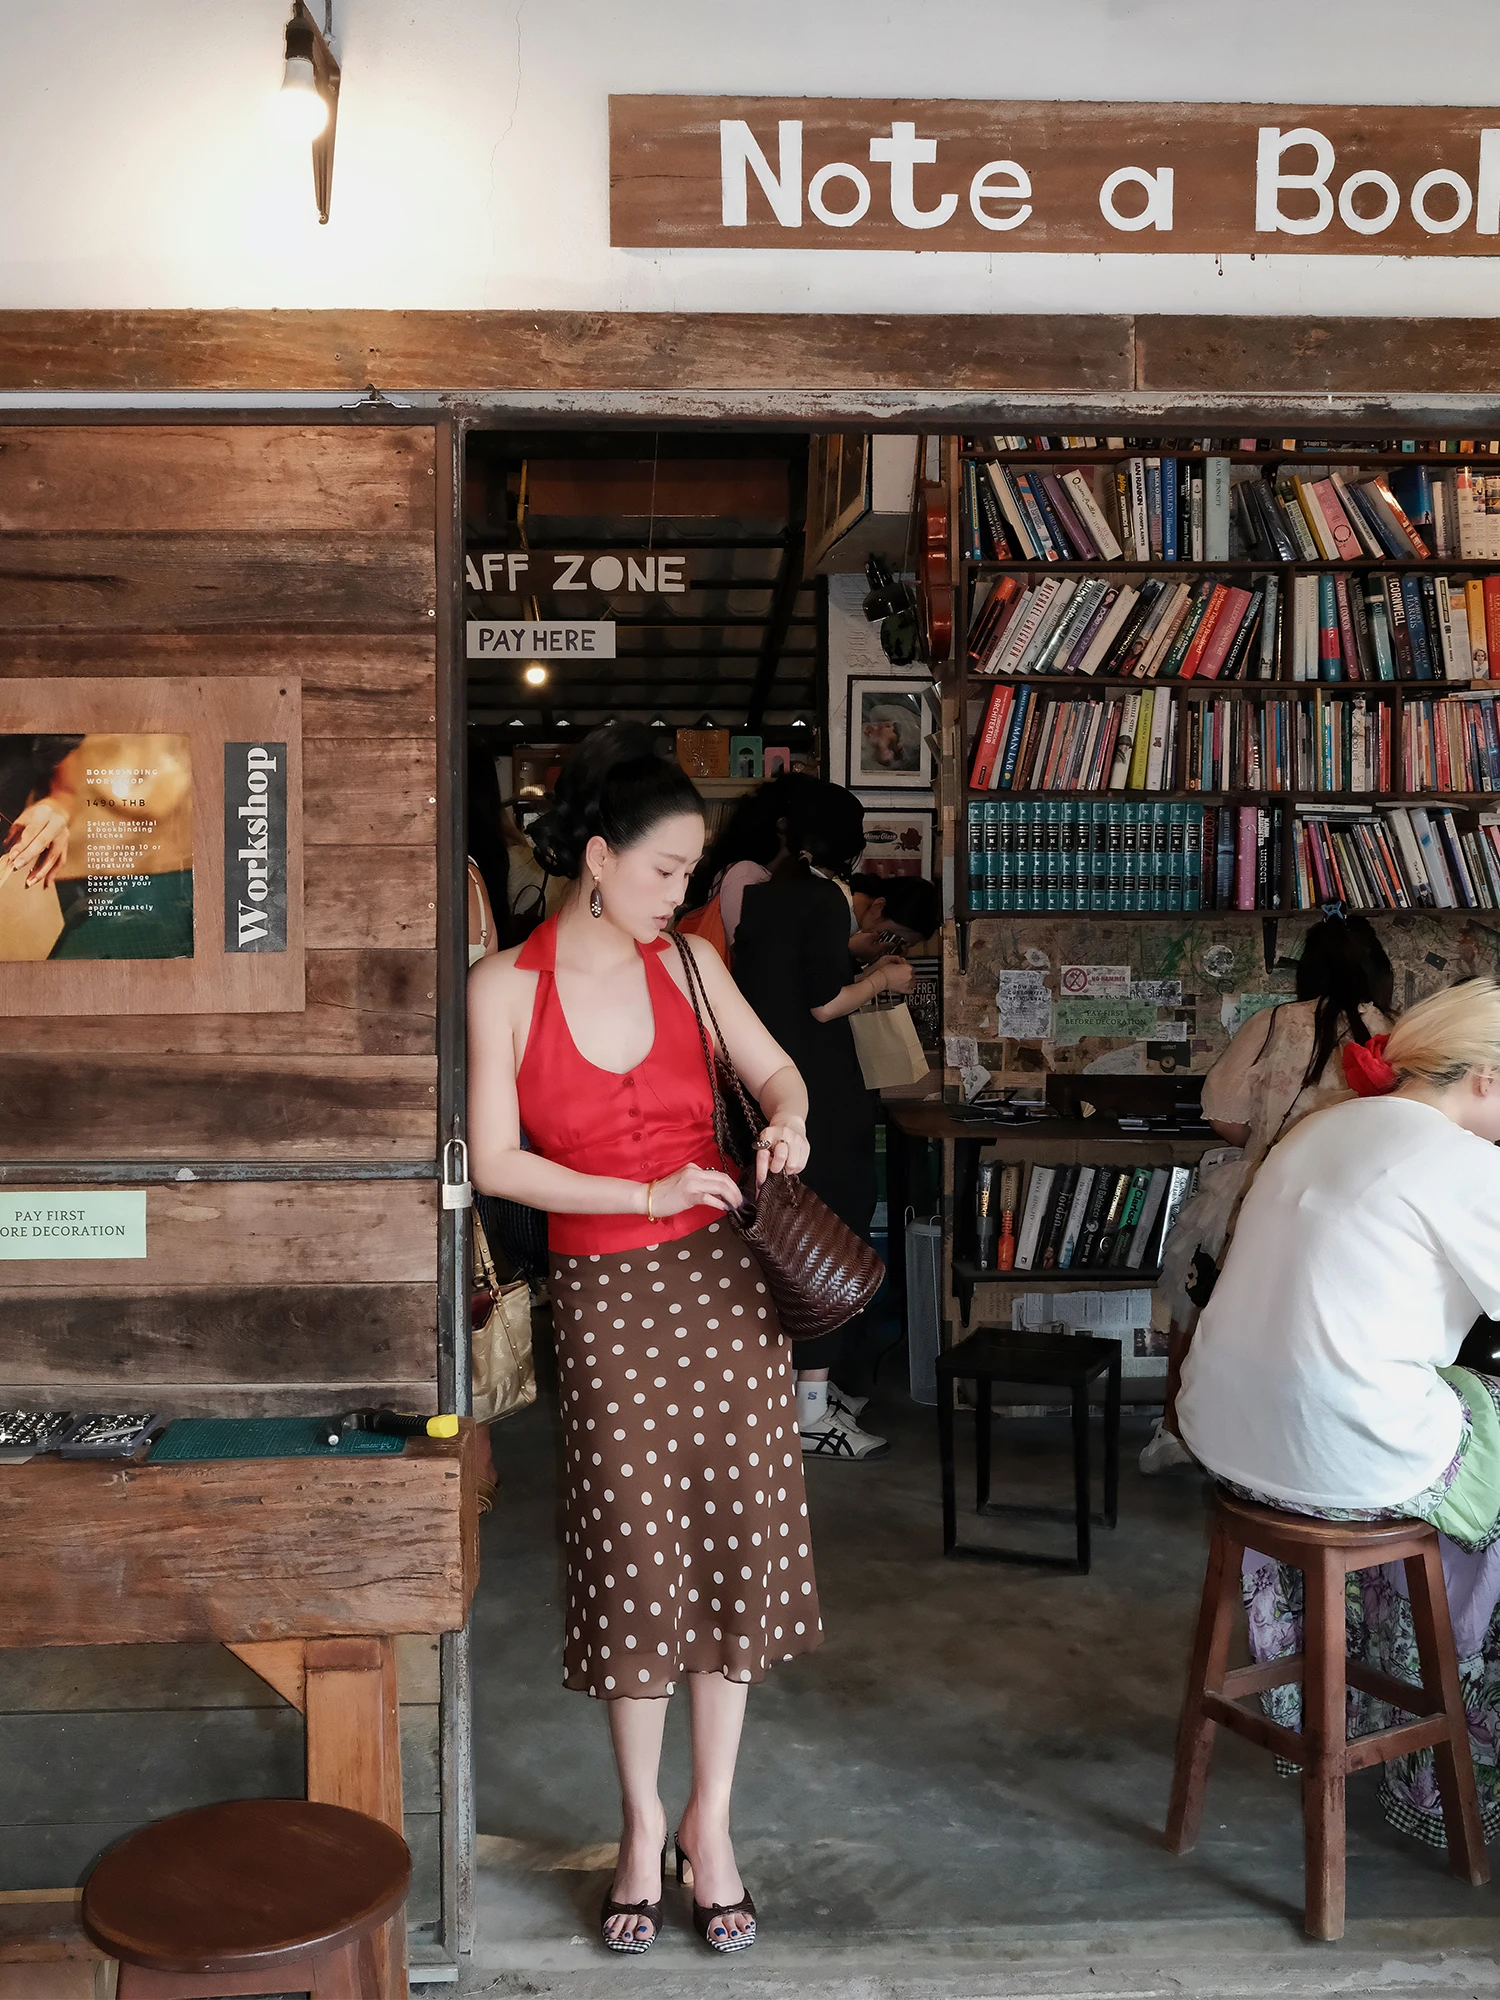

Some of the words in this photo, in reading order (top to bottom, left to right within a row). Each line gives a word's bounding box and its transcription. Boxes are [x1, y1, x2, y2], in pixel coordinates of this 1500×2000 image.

[720, 120, 1031, 230] Note
[1099, 167, 1173, 230] a
[1135, 477, 1143, 506] RANKIN
[1296, 518, 1315, 548] ROBINSON
[553, 556, 685, 592] ZONE
[1030, 583, 1055, 618] MICHAEL
[1076, 578, 1094, 601] JACK
[1214, 588, 1228, 612] Barbara
[1337, 580, 1348, 607] CATHERINE
[1355, 584, 1365, 610] CATHERINE
[1387, 581, 1408, 626] CORNWELL
[1060, 599, 1083, 631] HIGGINS
[1206, 610, 1218, 629] Taylor
[1219, 623, 1234, 647] NAMEN
[1228, 594, 1246, 623] GOTTES?
[1327, 609, 1335, 639] HUSSAIN
[1340, 607, 1351, 631] COOKSON
[1358, 611, 1369, 636] COOKSON
[1404, 594, 1419, 629] HARRIS
[1412, 596, 1423, 625] ROBERT
[479, 629, 525, 651] PAY
[534, 629, 595, 651] HERE
[1009, 619, 1036, 659] CRICHTON
[1195, 628, 1211, 654] Bradford
[1417, 637, 1430, 669] OFFICER
[1225, 644, 1241, 669] COLFER
[1020, 690, 1028, 707] JAMES
[1130, 696, 1138, 718] DANIELLE
[985, 698, 1001, 744] ARCHITEKTUR
[1010, 726, 1021, 750] MAN
[1006, 752, 1016, 771] LAB
[239, 748, 276, 947] Workshop
[1204, 814, 1213, 854] KOONTZ
[1260, 849, 1268, 883] unseen
[903, 994, 937, 1006] ARCHER
[1035, 1172, 1043, 1193] MAEVE
[1100, 1171, 1110, 1189] David
[1178, 1178, 1187, 1198] CONN
[15, 1211, 42, 1221] PAY
[47, 1211, 85, 1220] FIRST
[1053, 1191, 1072, 1228] Jordan
[1092, 1189, 1106, 1219] Baldacci
[1126, 1189, 1143, 1227] Clarkso
[0, 1227, 27, 1237] ORE
[33, 1226, 125, 1236] DECORATION
